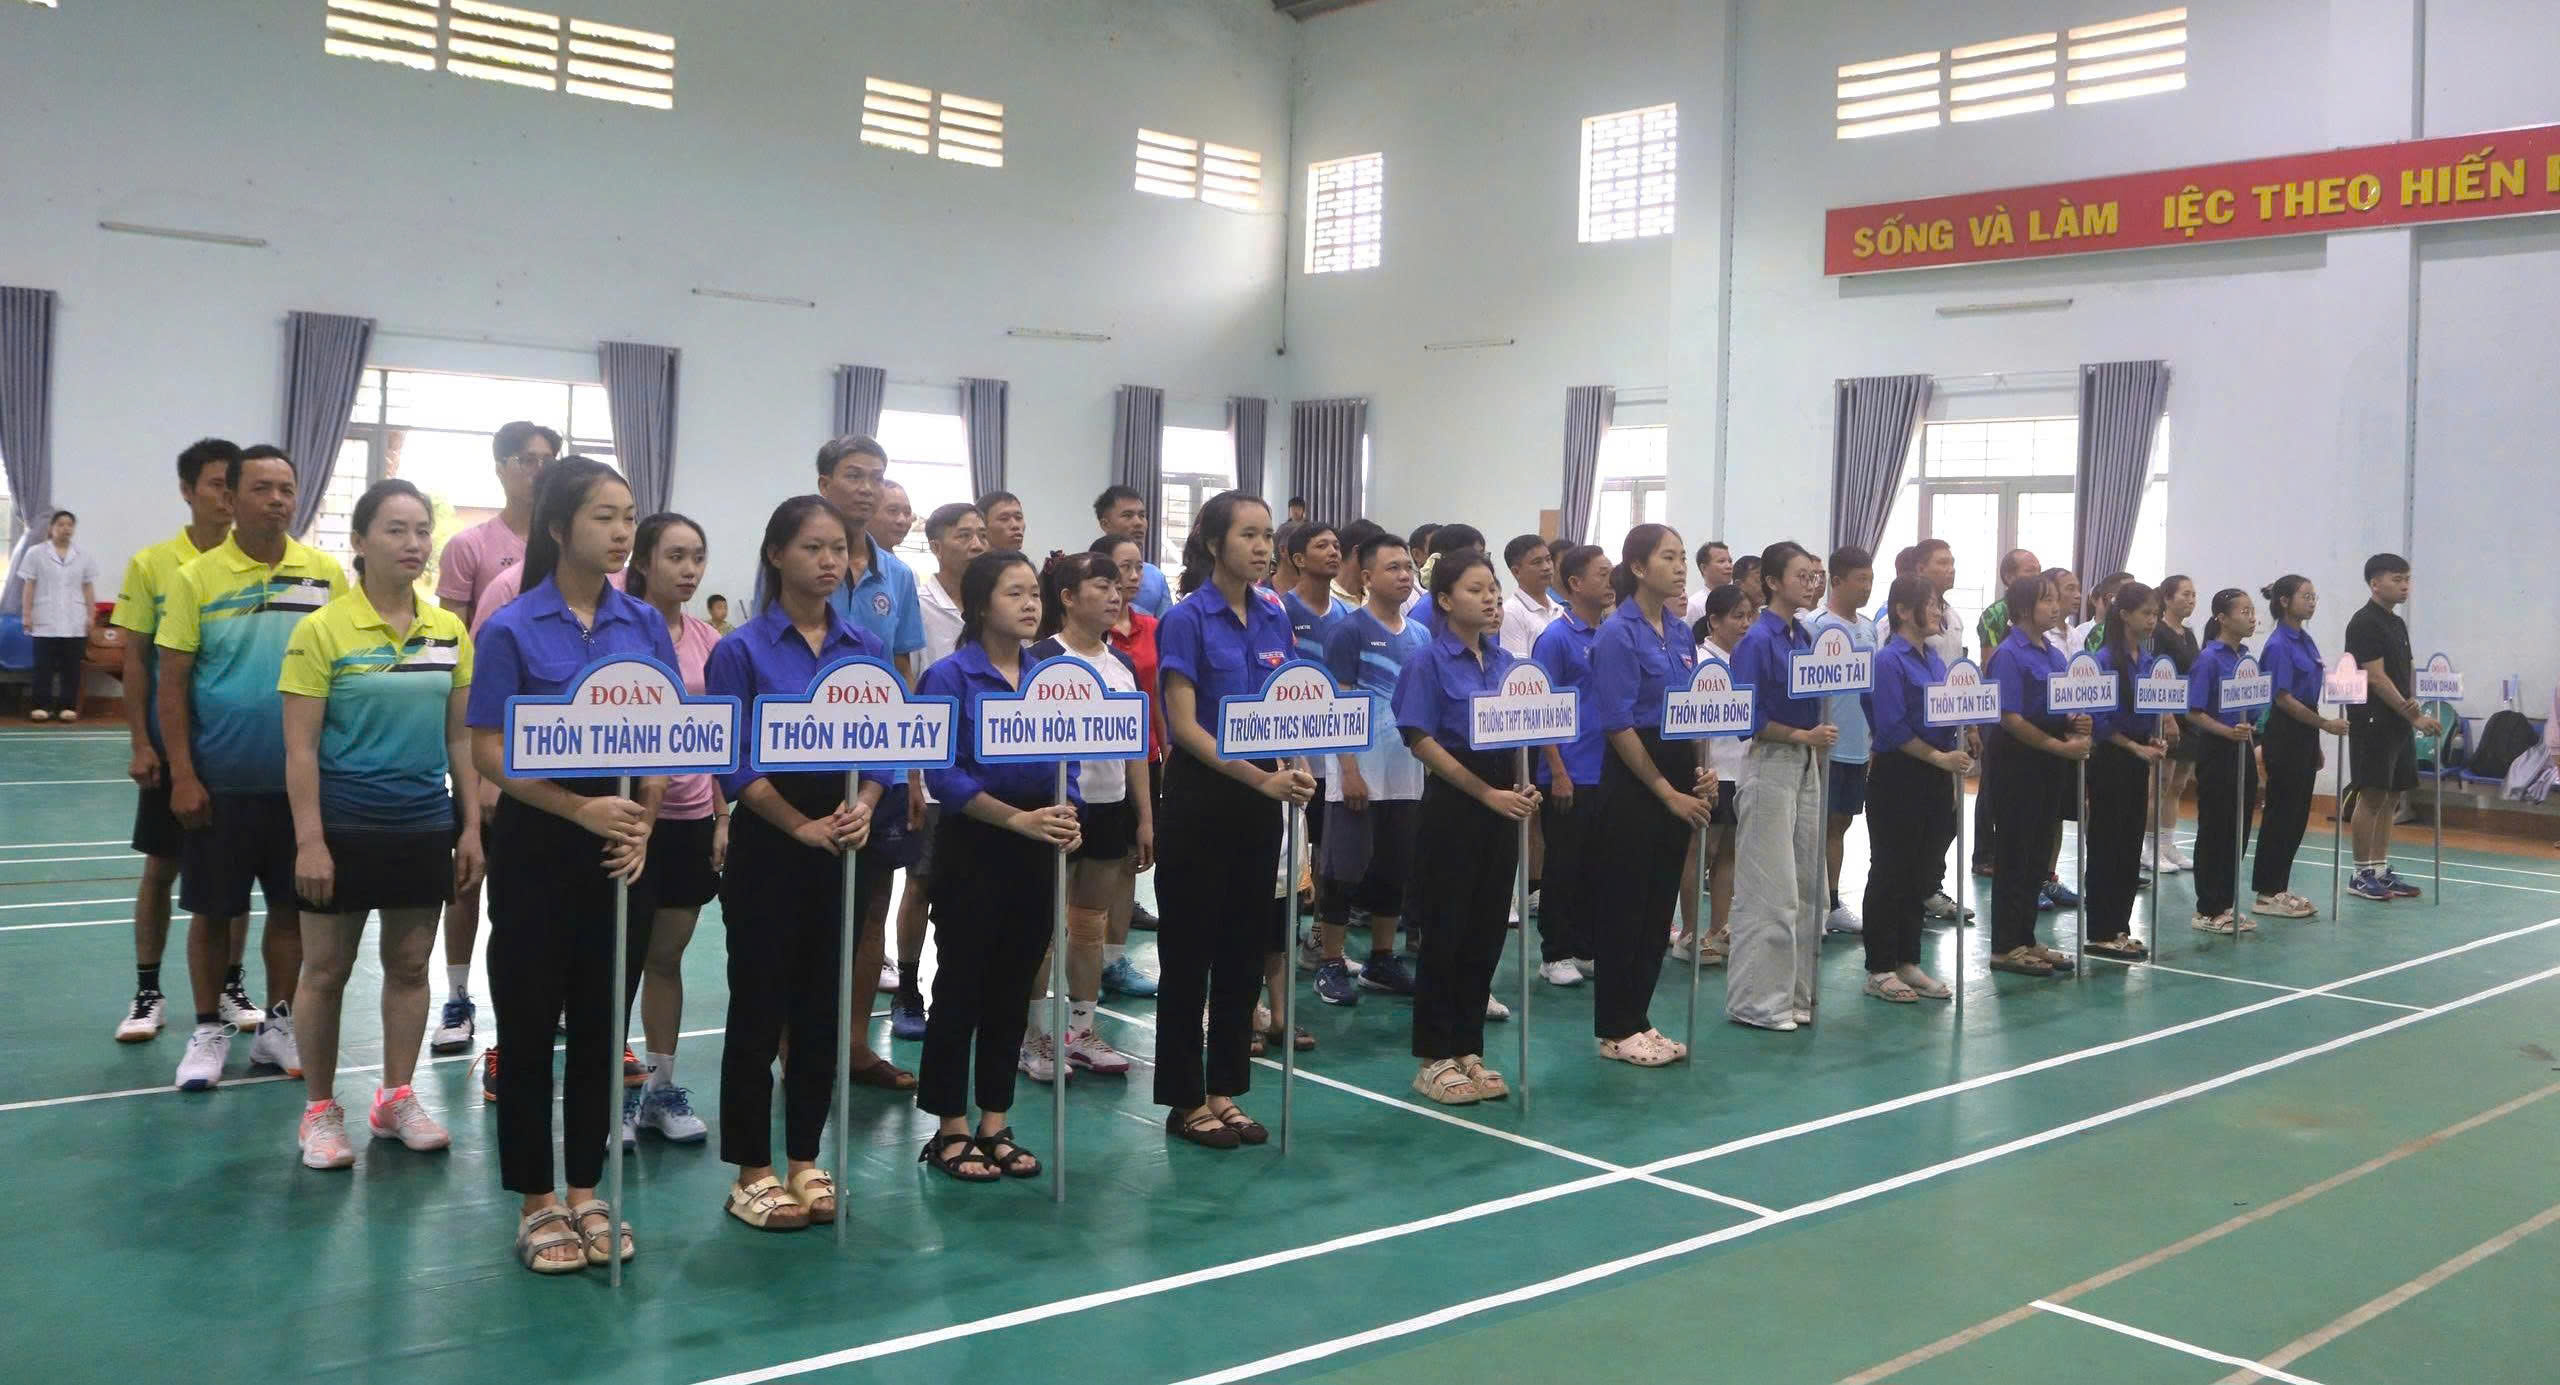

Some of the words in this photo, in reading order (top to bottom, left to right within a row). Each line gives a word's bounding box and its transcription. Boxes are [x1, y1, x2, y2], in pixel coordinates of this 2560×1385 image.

[1852, 212, 1956, 258] SỐNG
[1969, 205, 2015, 247] VÀ
[2029, 199, 2120, 243] LÀM
[2163, 185, 2236, 238] IỆC
[2251, 172, 2380, 222] THEO
[2400, 145, 2528, 206] HIẾN
[1697, 676, 1726, 692] ĐOÀN
[1799, 664, 1841, 688] TRỌNG
[1846, 658, 1866, 683] TÀI
[1951, 672, 1975, 686] ĐOÀN
[590, 679, 664, 706] ĐOÀN
[826, 680, 890, 704] ĐOÀN
[1037, 678, 1092, 701] ĐOÀN
[1276, 679, 1324, 702] ĐOÀN
[1509, 679, 1543, 696] ĐOÀN
[2055, 687, 2073, 703] BAN
[2075, 686, 2098, 703] CHQS
[2100, 681, 2112, 700] XÃ
[1670, 700, 1697, 724] THÔN
[1700, 699, 1720, 723] HÒA
[1723, 698, 1749, 723] ĐÔNG
[1930, 694, 1955, 714] THÔN
[1955, 692, 1975, 713] TÂN
[1976, 688, 1996, 711] TIẾN
[768, 714, 834, 750] THÔN
[842, 714, 889, 749] HÒA
[897, 713, 942, 749] TÂY
[988, 711, 1036, 744] THÔN
[1042, 710, 1076, 742] HÒA
[1081, 716, 1137, 742] TRUNG
[1230, 709, 1271, 742] TRƯỜNG
[1273, 715, 1298, 739] THCS
[1302, 702, 1340, 737] NGUYỄN
[1343, 706, 1365, 736] TRÃI
[1478, 705, 1504, 731] TRƯỜNG
[1505, 707, 1520, 728] THPT
[1522, 706, 1540, 732] PHẠM
[523, 716, 582, 755] THÔN
[590, 717, 661, 754] THÀNH
[668, 715, 724, 753] CÔNG
